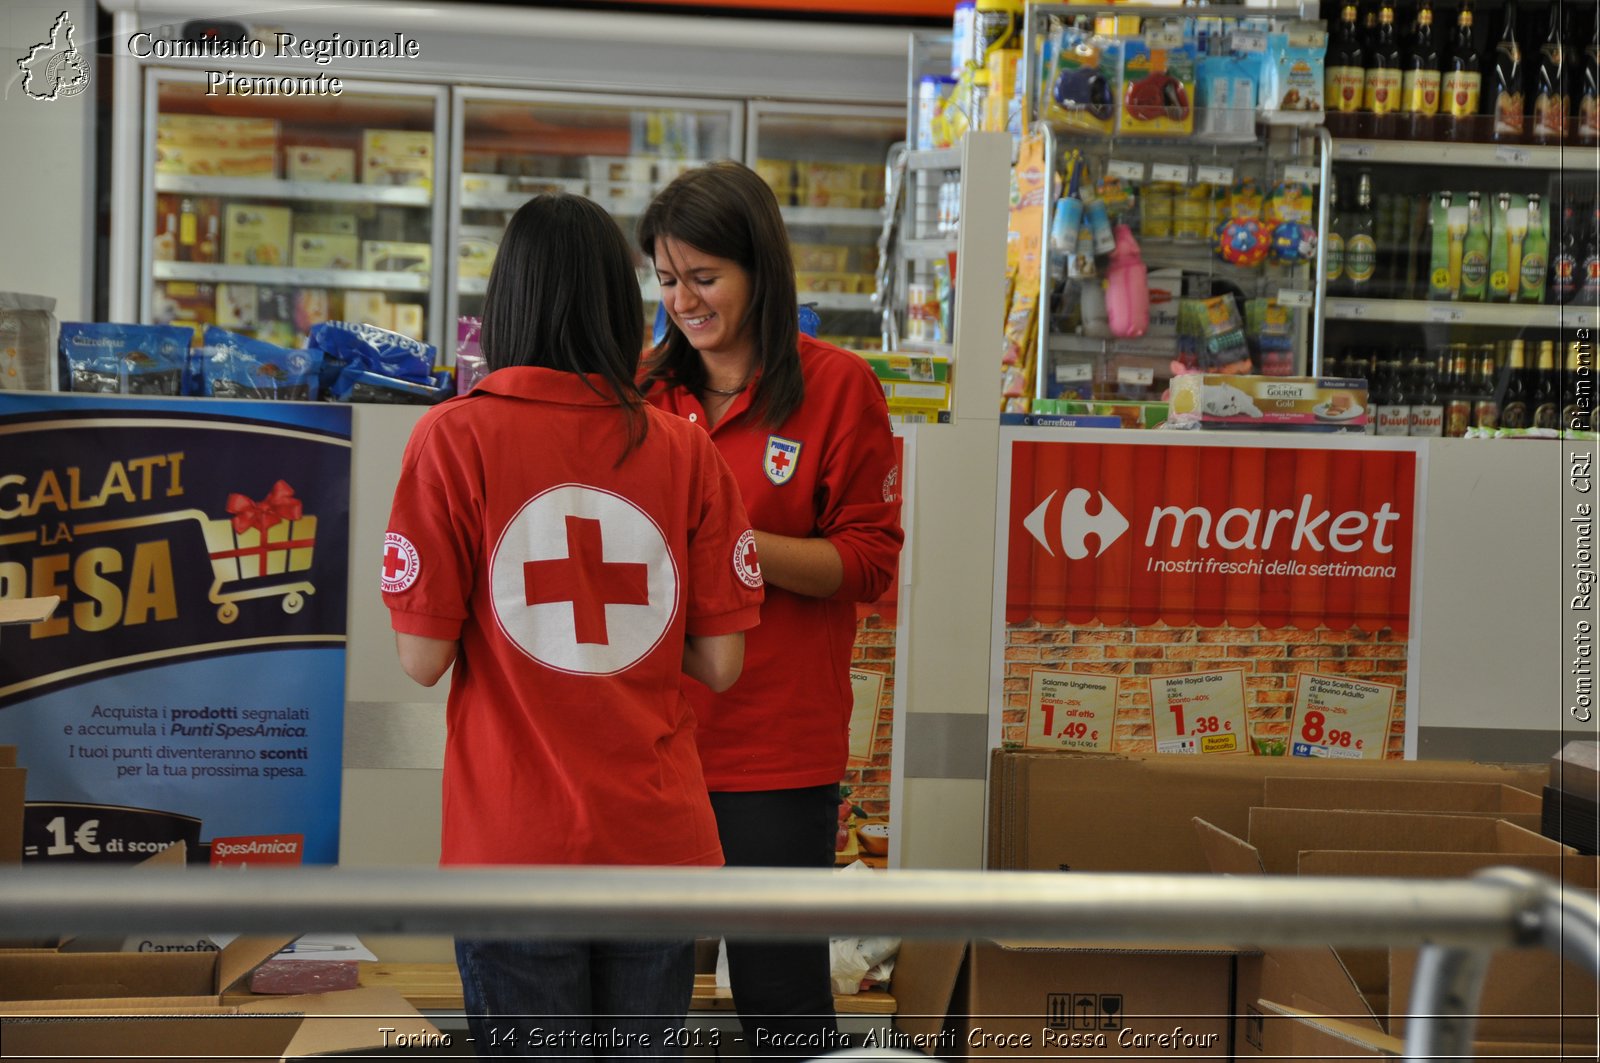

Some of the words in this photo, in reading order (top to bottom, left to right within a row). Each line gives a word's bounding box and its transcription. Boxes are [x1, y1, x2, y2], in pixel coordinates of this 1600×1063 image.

[1267, 388, 1304, 398] GOURMET
[1276, 399, 1295, 409] Gold
[1037, 417, 1077, 427] Carrefour
[1380, 413, 1409, 426] Duvel
[1411, 413, 1441, 426] Duvel
[770, 440, 798, 454] PIONIERI
[1144, 493, 1401, 554] market
[40, 522, 73, 546] LA
[403, 541, 418, 578] ITALIANA
[1147, 556, 1154, 573] I
[1155, 557, 1205, 574] nostri
[1206, 557, 1264, 577] freschi
[1265, 558, 1307, 577] della
[1307, 559, 1397, 579] settimana
[1042, 678, 1069, 688] Salame
[1070, 681, 1107, 692] Ungherese
[1166, 679, 1184, 687] Mele
[1184, 676, 1204, 686] Royal
[1310, 677, 1331, 688] Polpa
[1332, 680, 1354, 691] Scelta
[1354, 683, 1380, 694] Coscia
[1317, 686, 1341, 696] Bovino
[1341, 690, 1365, 699] Adulto
[91, 704, 158, 720] Acquista
[162, 705, 167, 719] i
[171, 706, 238, 723] prodotti
[242, 706, 310, 723] segnalati
[1306, 703, 1330, 712] Sconto
[64, 724, 73, 736] e
[78, 723, 156, 737] accumula
[161, 723, 166, 736] i
[170, 723, 213, 737] Punti
[1223, 720, 1232, 731] €
[1091, 730, 1099, 741] €
[1204, 743, 1234, 752] Raccolto
[1355, 739, 1364, 750] €
[69, 744, 75, 759] I
[79, 745, 108, 759] tuoi
[112, 745, 153, 761] punti
[156, 745, 256, 760] diventeranno
[259, 747, 309, 761] sconti
[117, 764, 143, 779] per
[146, 763, 159, 777] la
[163, 765, 188, 777] tua
[191, 764, 260, 780] prossima
[263, 765, 307, 779] spesa.
[105, 839, 123, 853] di
[214, 838, 299, 858] SpesAmica
